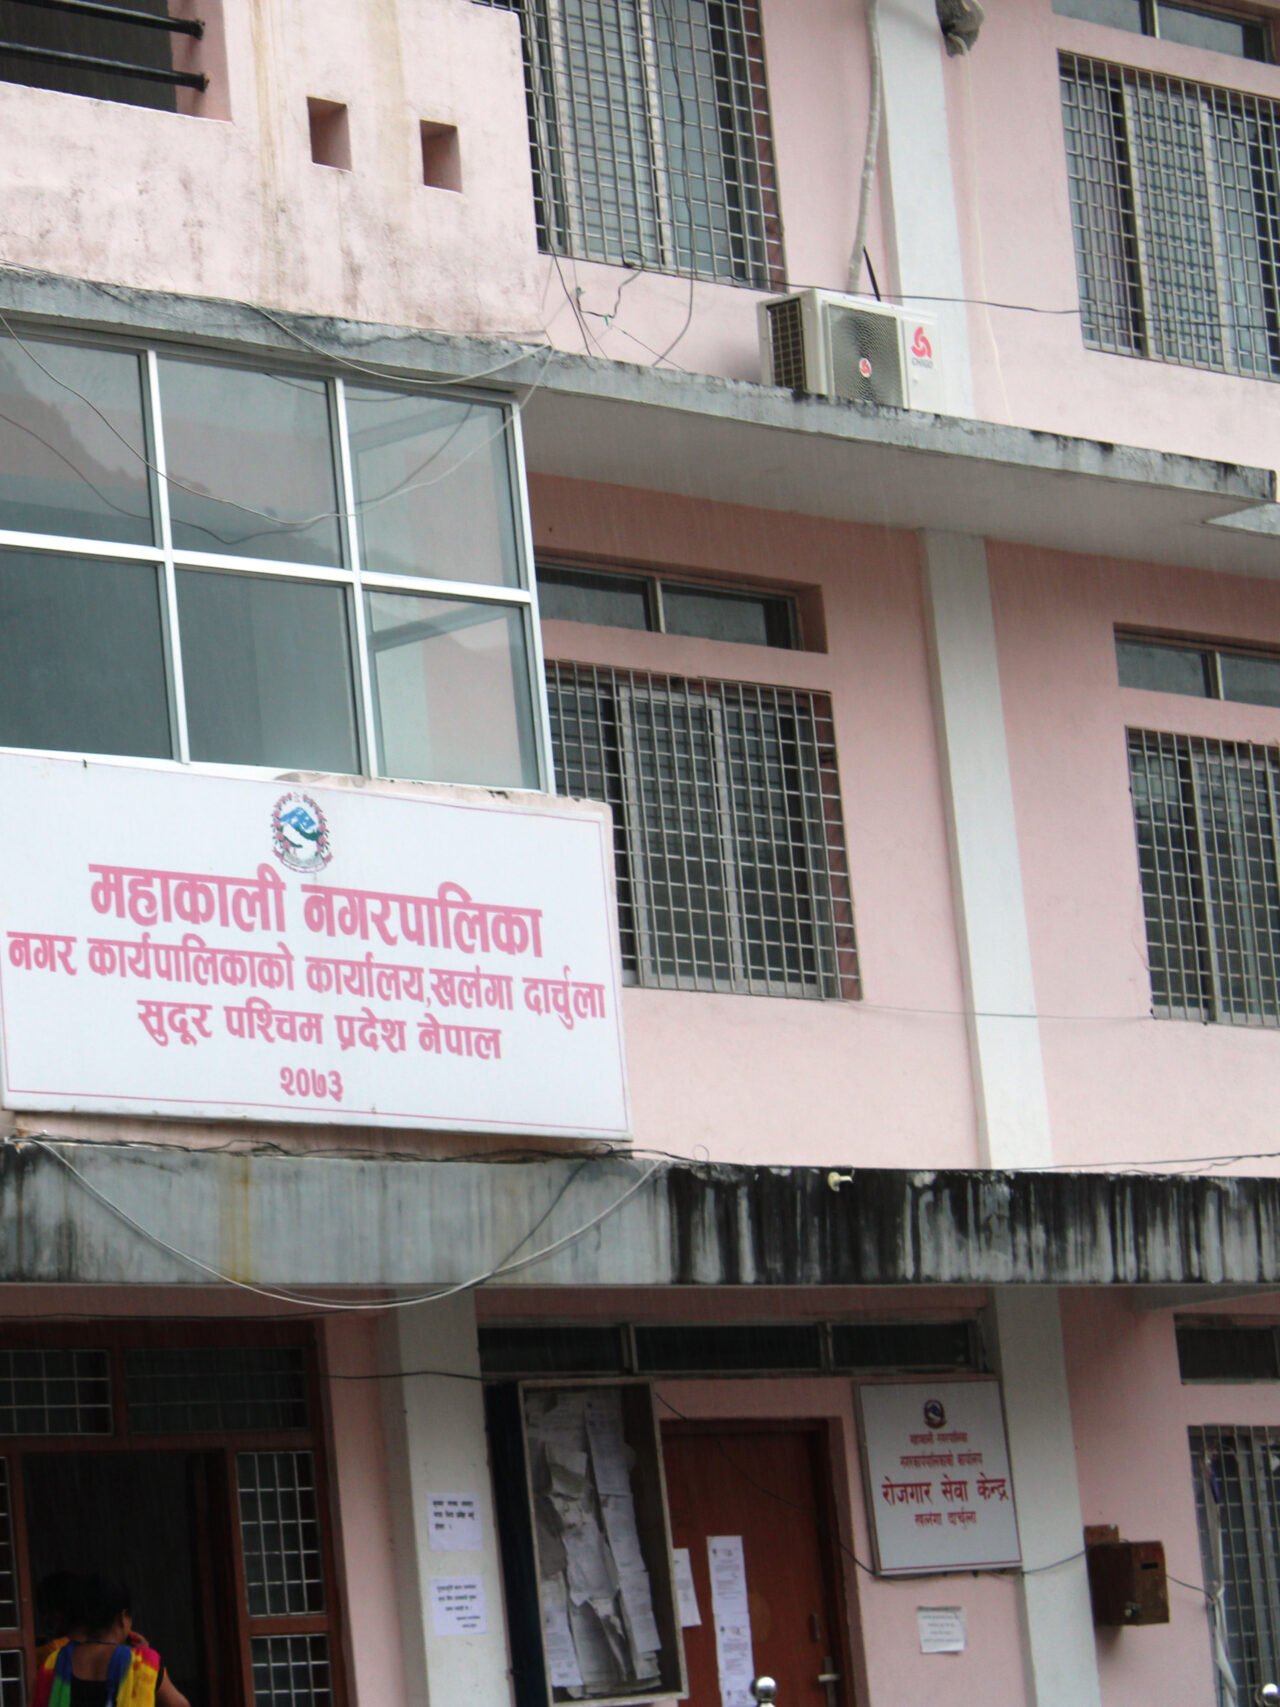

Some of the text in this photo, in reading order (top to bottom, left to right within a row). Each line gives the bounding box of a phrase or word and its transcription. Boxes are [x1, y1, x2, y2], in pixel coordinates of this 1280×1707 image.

[88, 863, 543, 957] महाकाली नगरपालिका
[6, 930, 77, 976] नगर
[87, 932, 294, 991] कार्यपालिकाको
[522, 965, 606, 1030] दार्चुला
[137, 996, 502, 1060] सुदूर पश्चिम प्रदेश नेपाल
[280, 1067, 344, 1102] २०७३
[881, 1472, 1009, 1505] रोजगार सेवा केन्द्र
